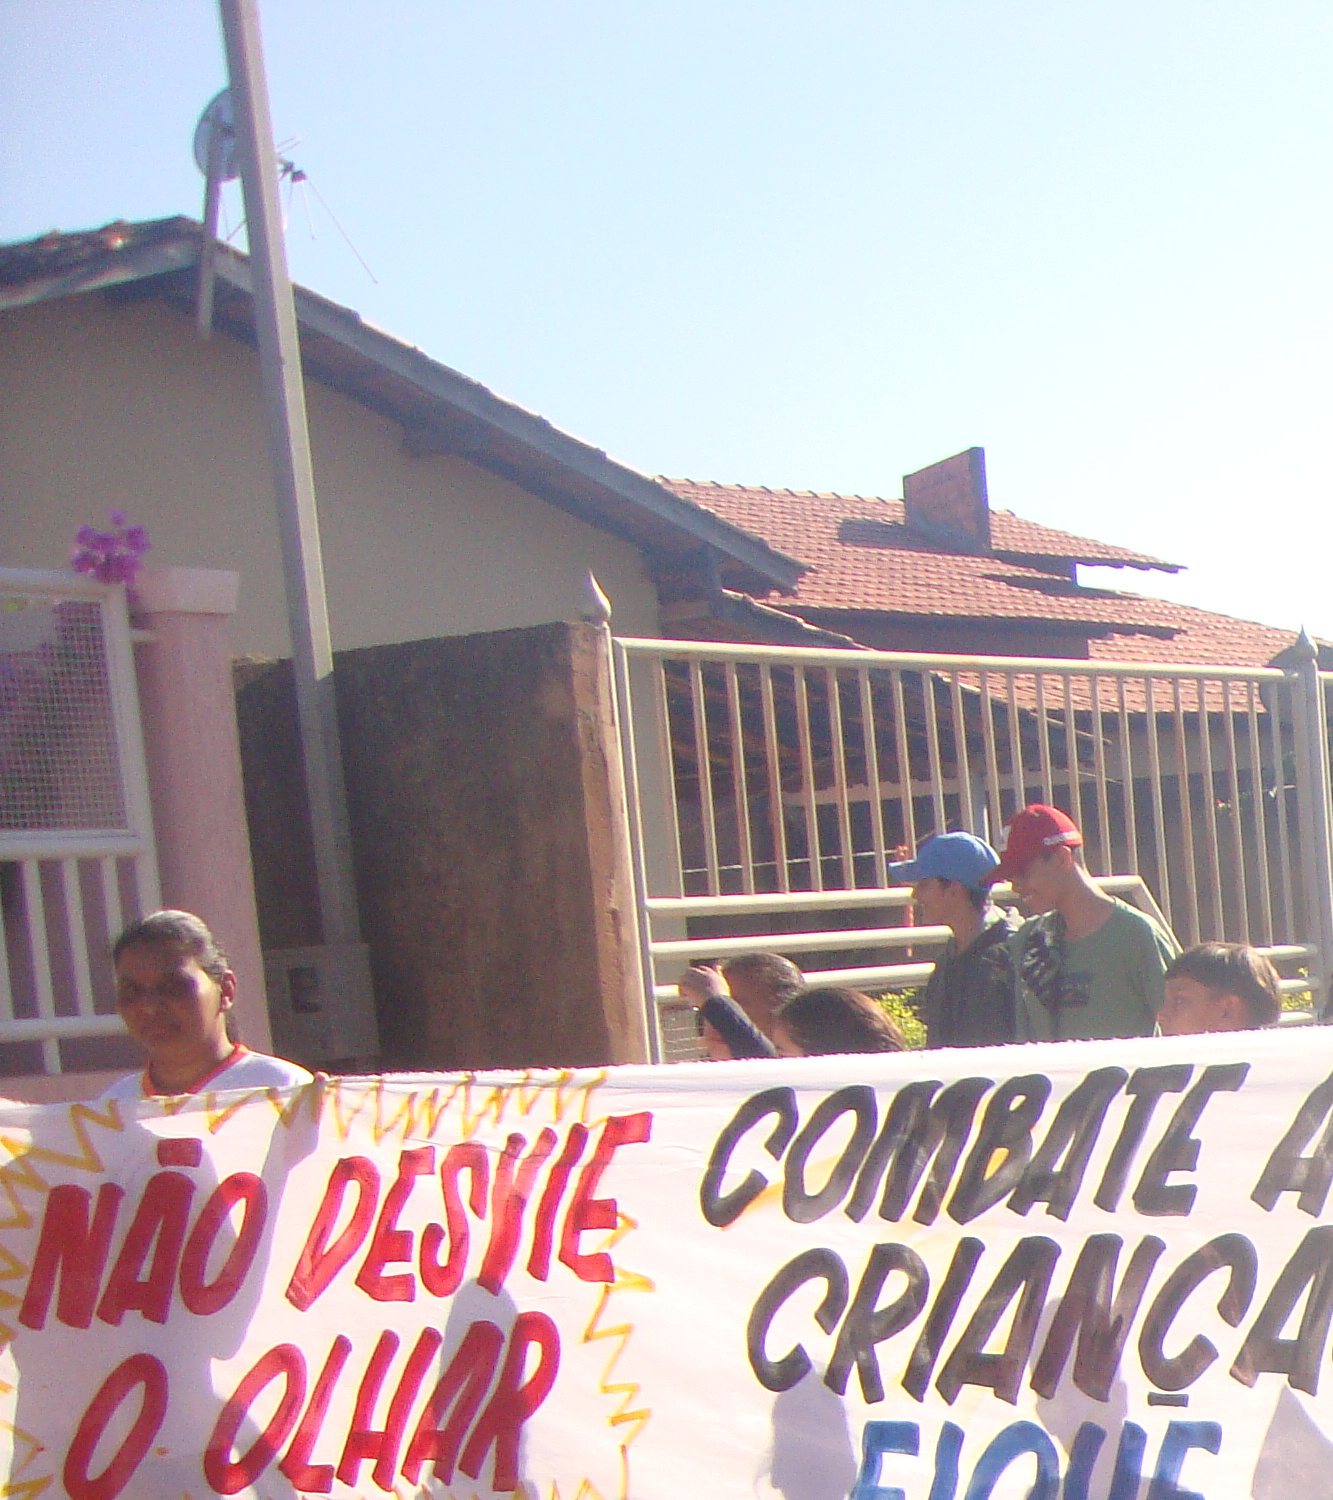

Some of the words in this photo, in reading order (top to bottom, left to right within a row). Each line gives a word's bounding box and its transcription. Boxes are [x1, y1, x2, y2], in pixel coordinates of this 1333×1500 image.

[18, 1138, 268, 1330] NÃO
[284, 1112, 652, 1312] DESVIE
[700, 1061, 1252, 1228] COMBATE
[204, 1310, 561, 1495] OLHAR
